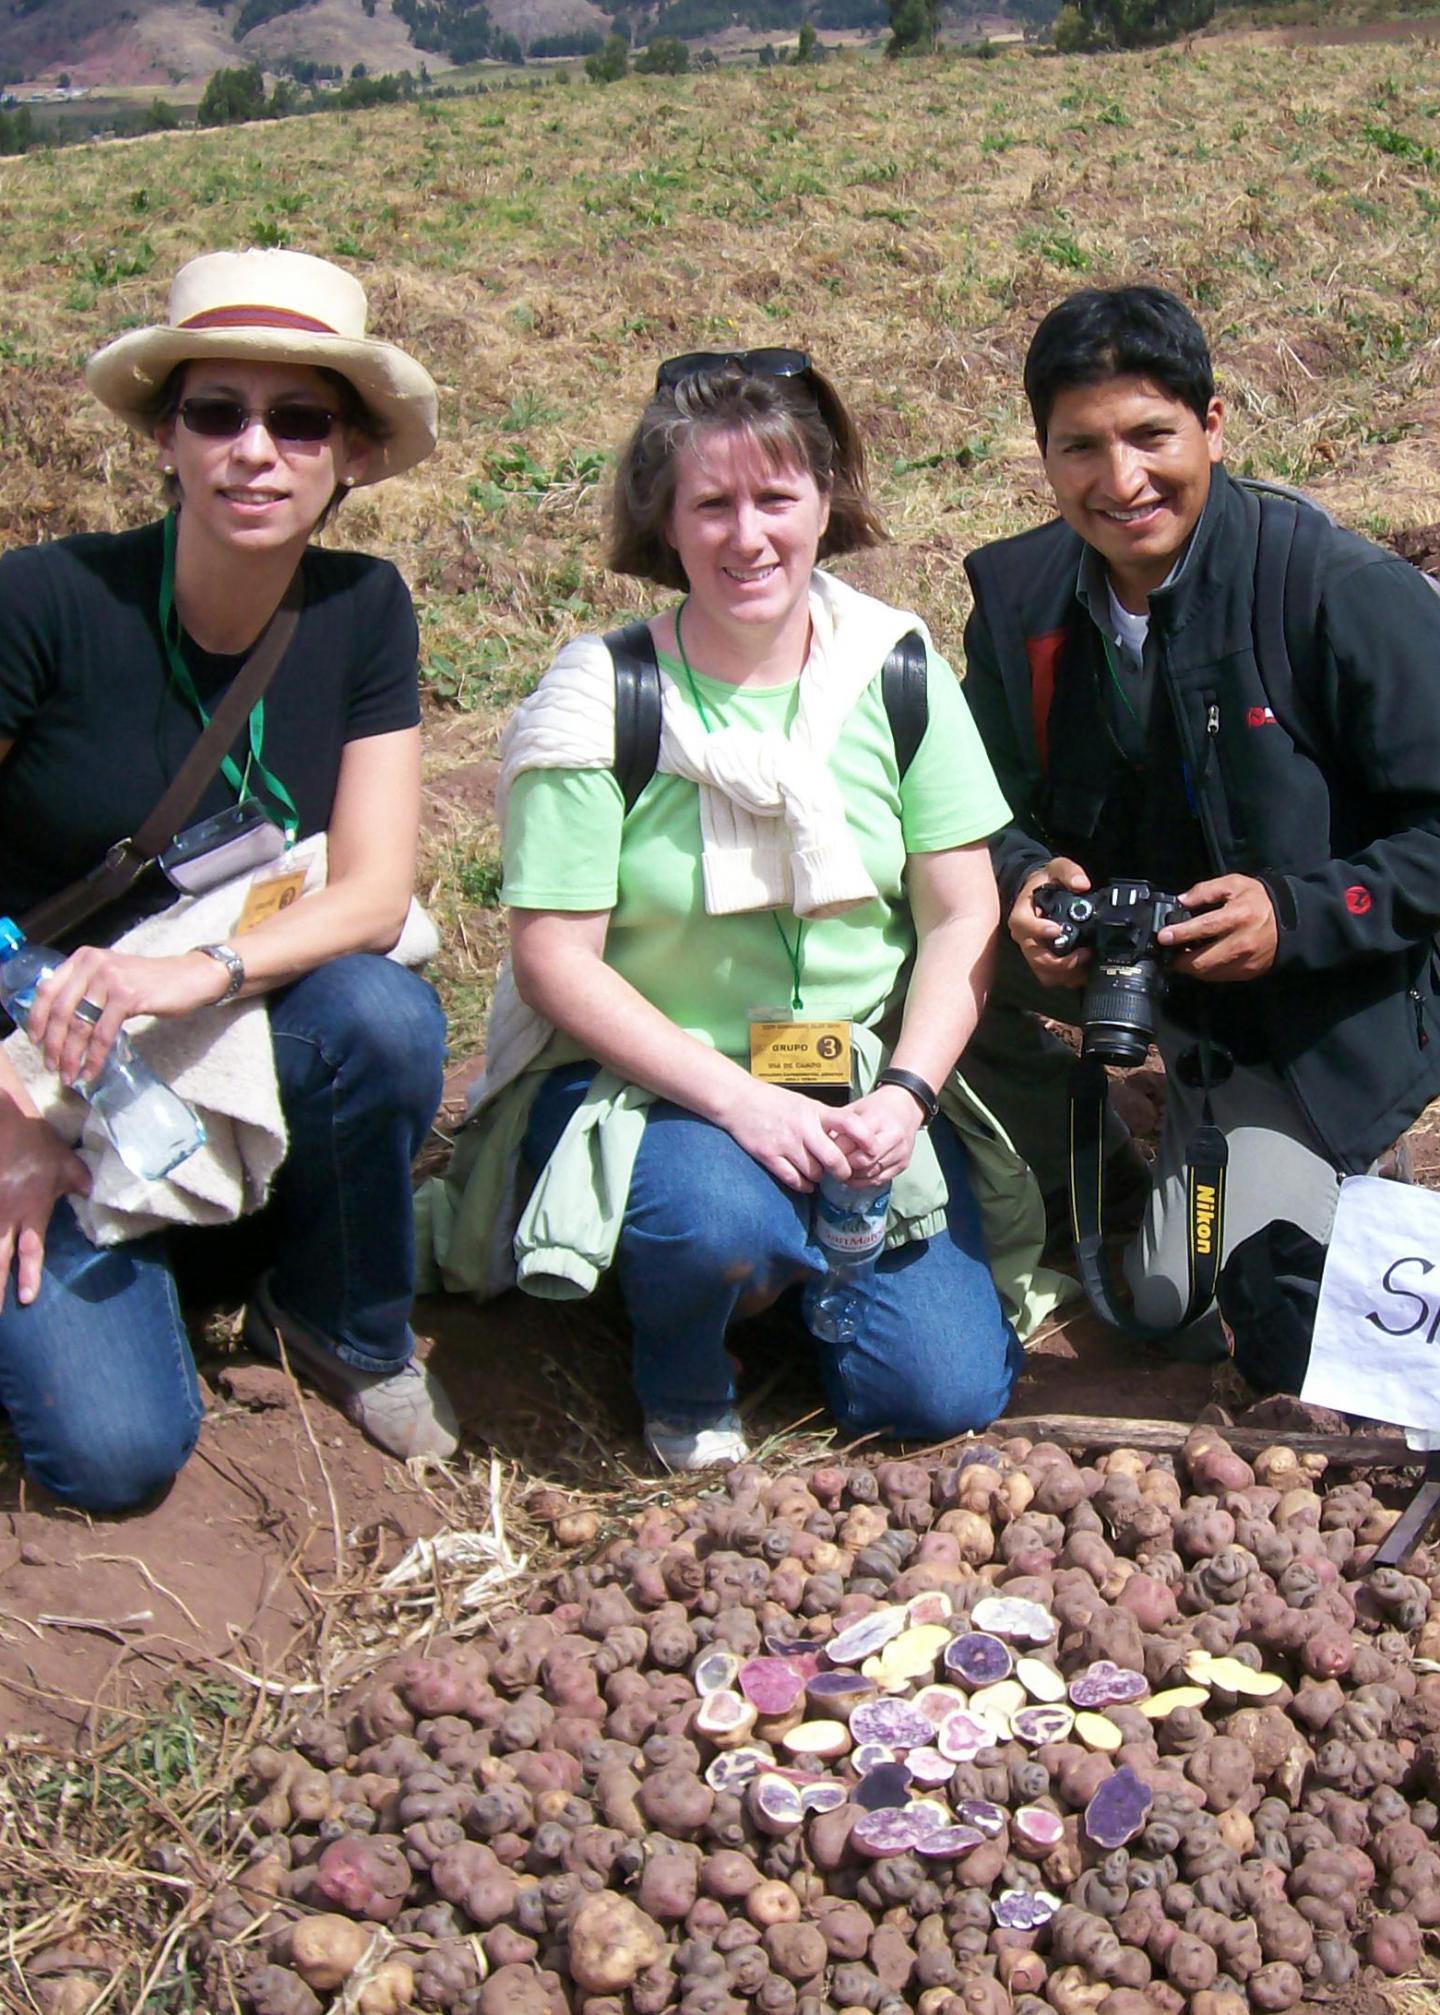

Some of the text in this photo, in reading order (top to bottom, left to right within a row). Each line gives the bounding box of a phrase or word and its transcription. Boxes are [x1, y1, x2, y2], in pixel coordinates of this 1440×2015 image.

[772, 1038, 837, 1058] GRUPO 3
[1196, 1184, 1216, 1254] Nikon
[1365, 1257, 1440, 1344] S
